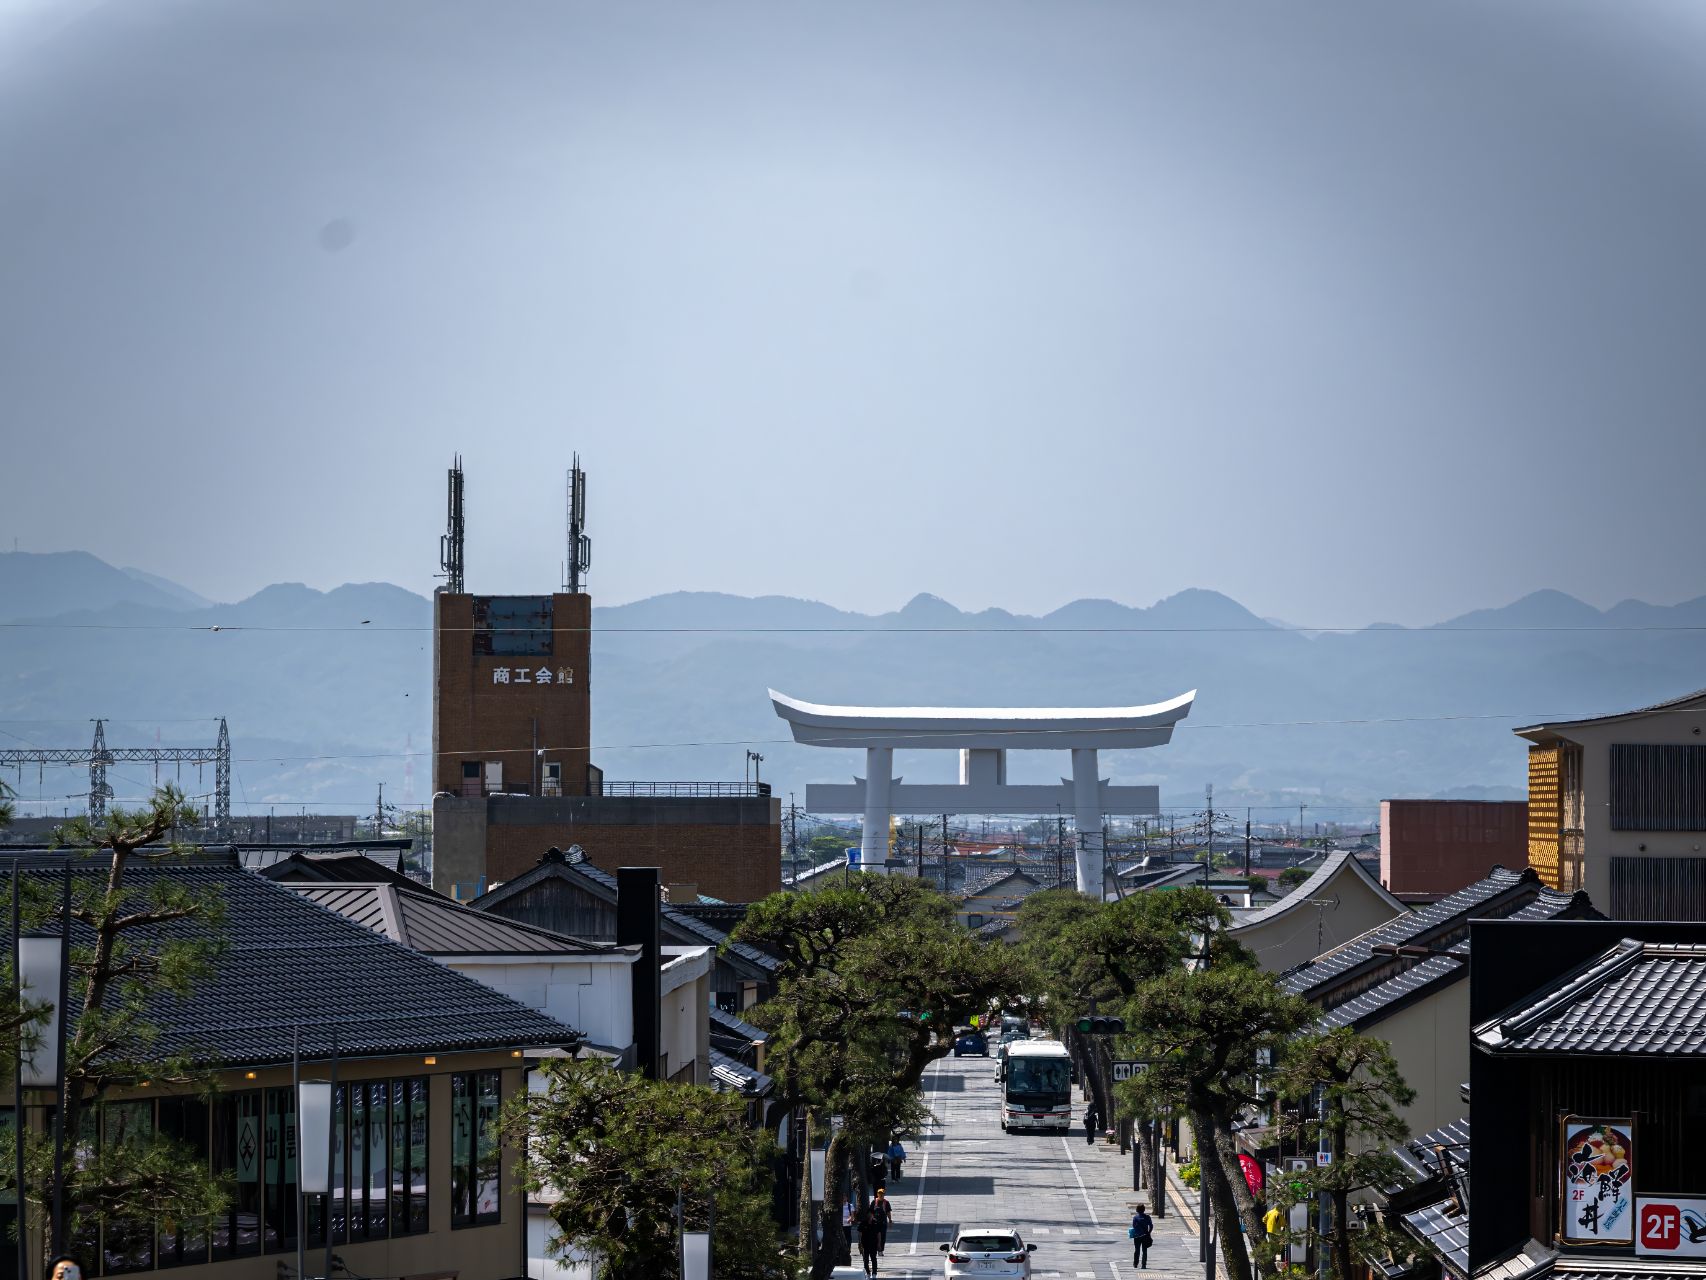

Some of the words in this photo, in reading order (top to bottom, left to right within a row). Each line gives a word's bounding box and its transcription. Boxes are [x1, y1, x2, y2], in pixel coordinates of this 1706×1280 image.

[493, 666, 574, 684] 商工会館
[1569, 1143, 1629, 1235] 海鮮丼
[1572, 1190, 1585, 1201] 2F
[1646, 1214, 1675, 1239] 2F
